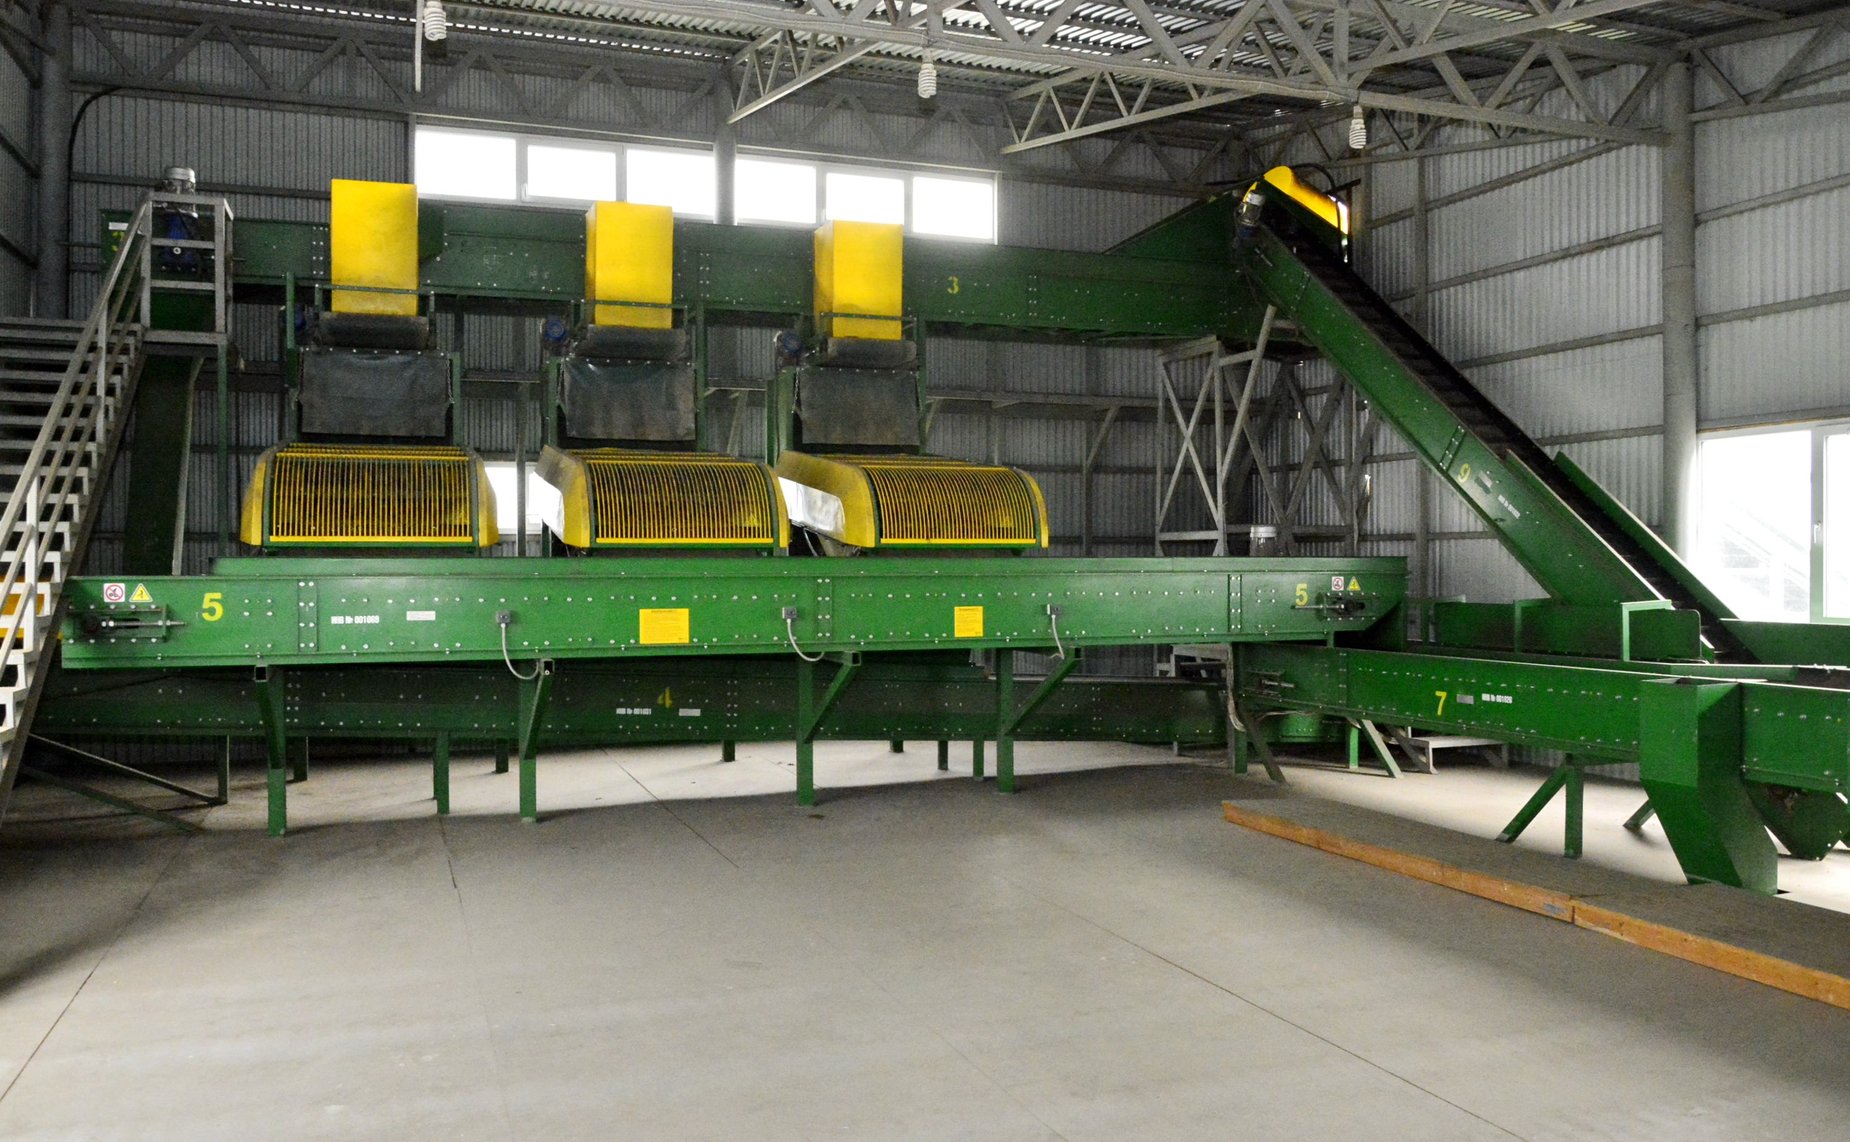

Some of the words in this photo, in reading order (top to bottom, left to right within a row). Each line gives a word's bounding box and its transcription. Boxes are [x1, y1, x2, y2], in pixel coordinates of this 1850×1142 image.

[947, 276, 959, 294] 3
[1458, 463, 1471, 483] 9
[1295, 583, 1308, 606] 5
[201, 592, 224, 622] 5
[657, 686, 672, 709] 4
[1435, 690, 1447, 716] 7
